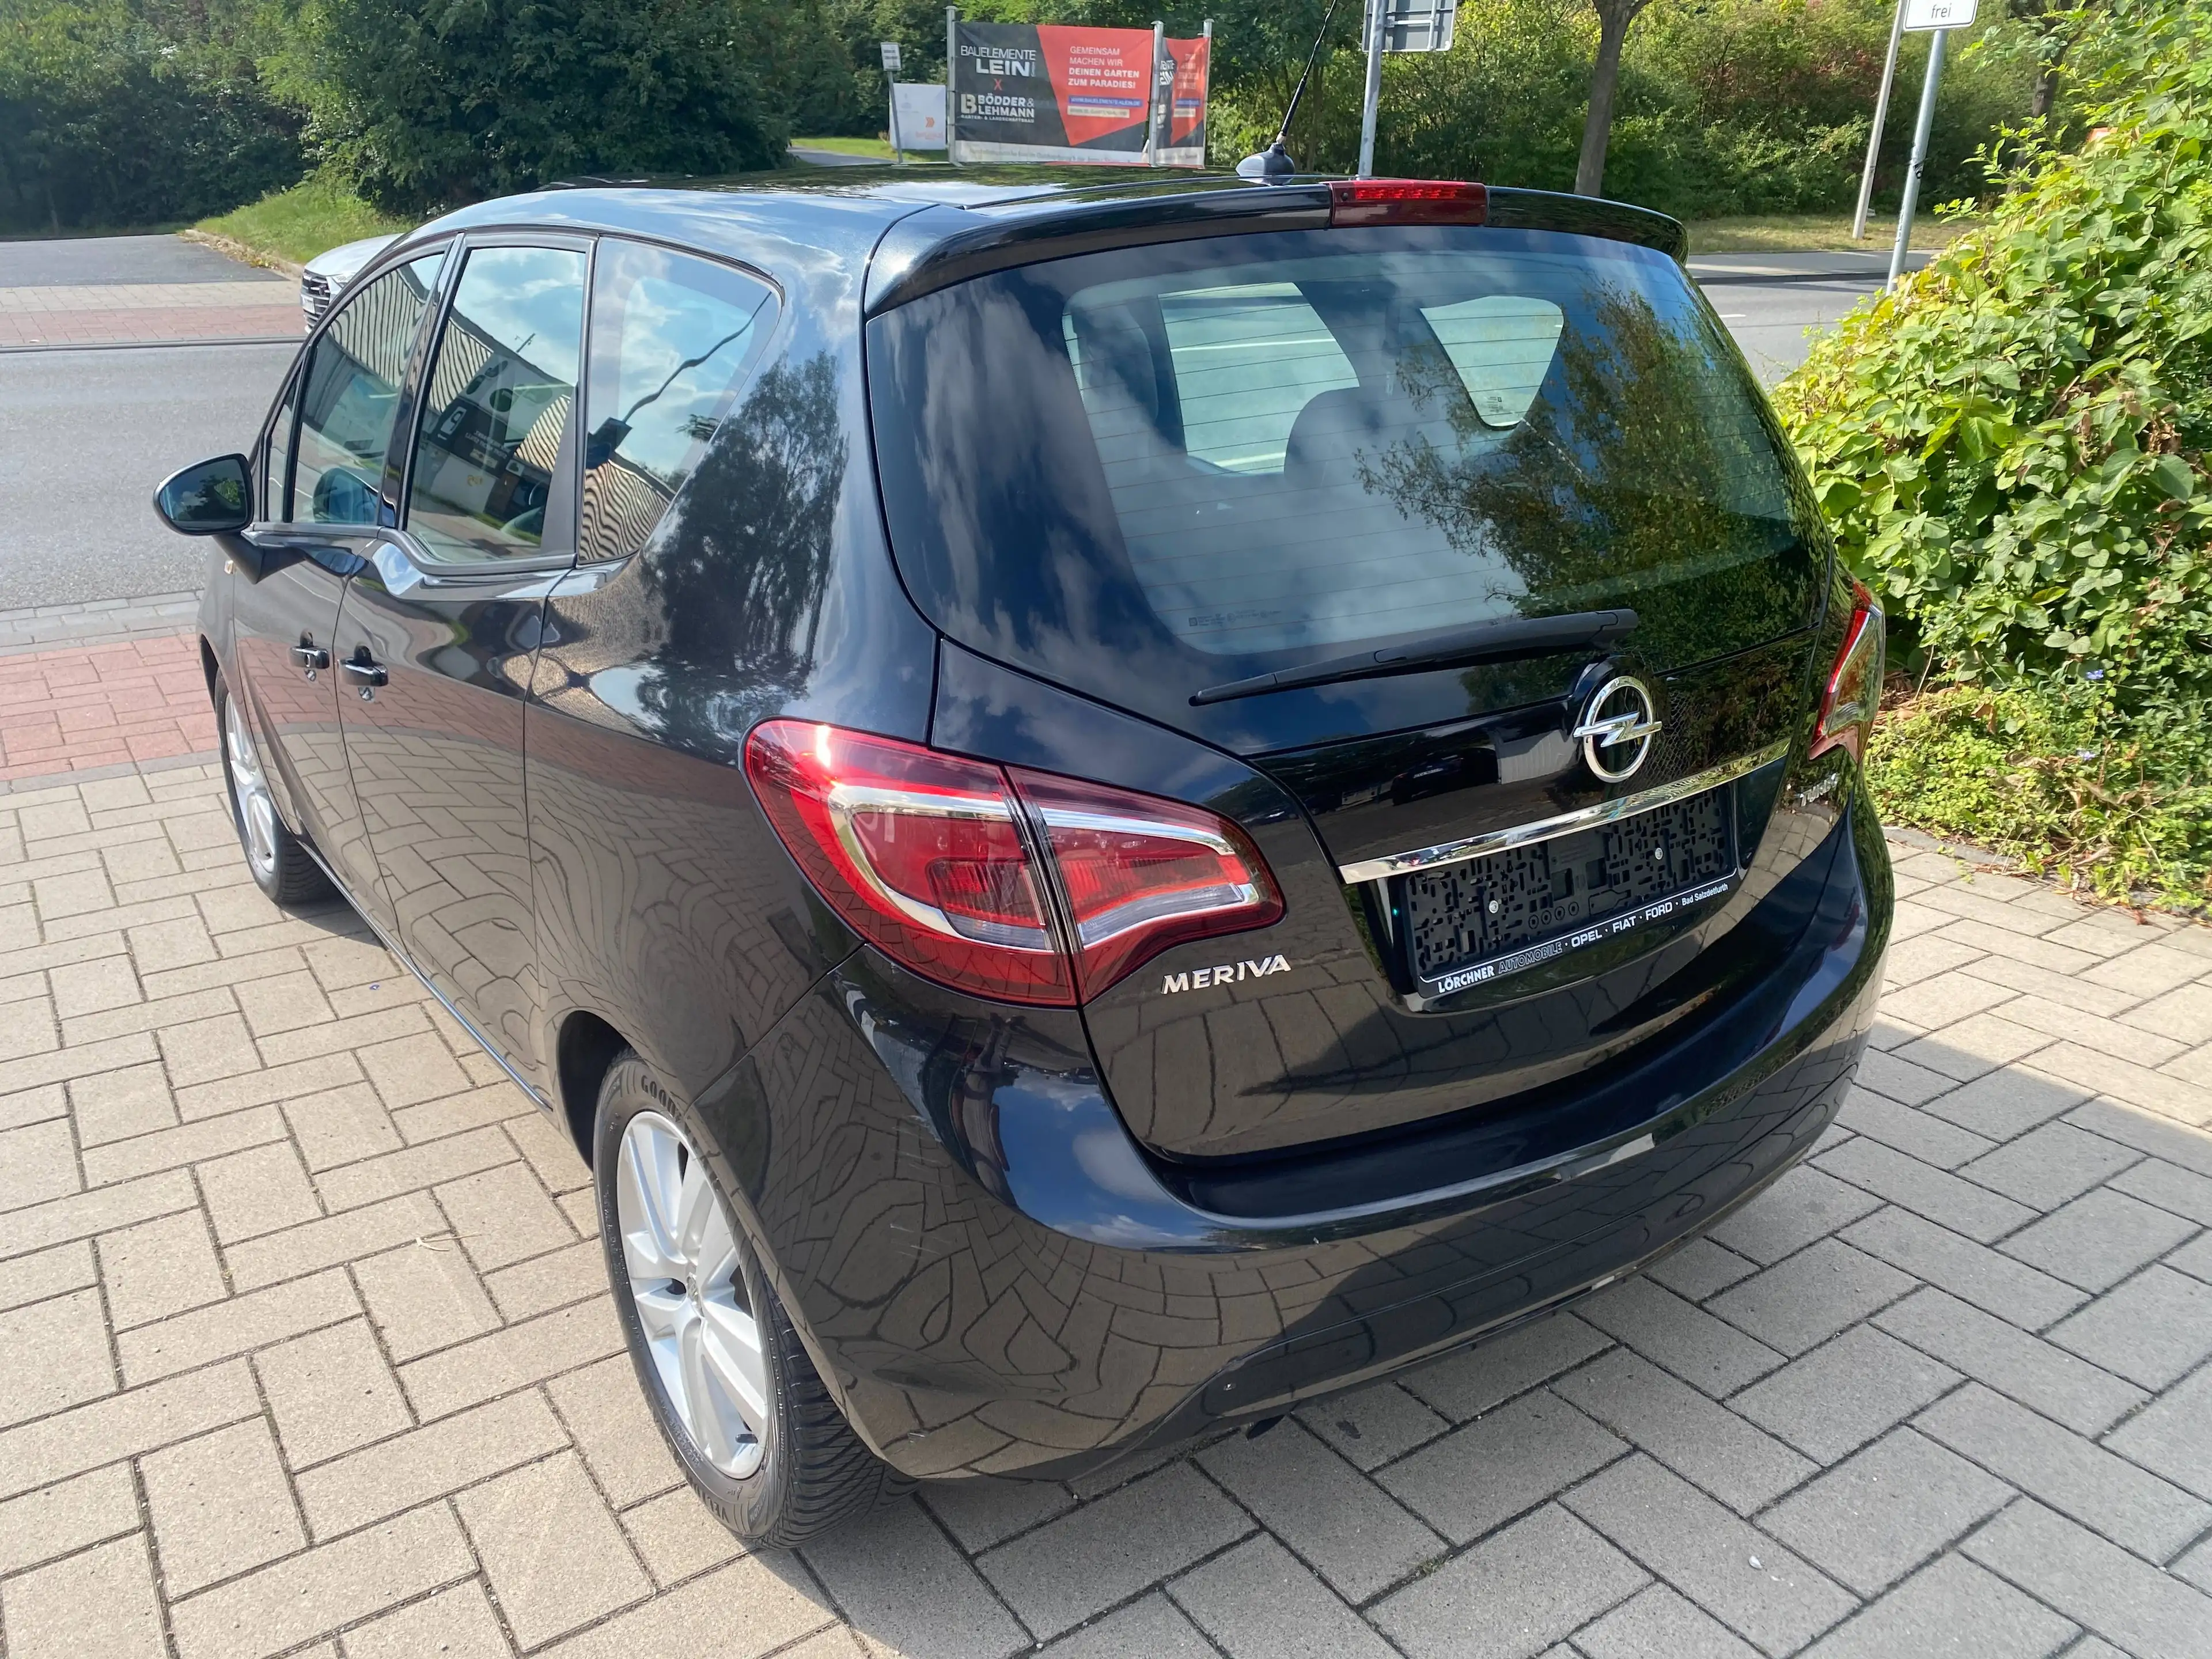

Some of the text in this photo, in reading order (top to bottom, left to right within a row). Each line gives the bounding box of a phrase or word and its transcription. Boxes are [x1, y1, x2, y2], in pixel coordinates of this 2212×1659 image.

[1931, 3, 1952, 18] frei
[960, 46, 1036, 60] BAUELEMENTE
[1070, 46, 1120, 55] GEMEINSAM
[976, 58, 1030, 77] LEIN
[1070, 56, 1123, 67] MACHEN WIR
[1069, 67, 1139, 78] DEINEN GARTEN
[1068, 78, 1087, 86] ZUM
[978, 93, 1026, 107] BÖDDER
[978, 105, 1035, 118] LEHMANN
[1437, 882, 1729, 994] LÖRCHNER AUTOMOBILE OPEL FIAT FORD Bad Salzdetfurth
[1161, 954, 1291, 995] MERIVA
